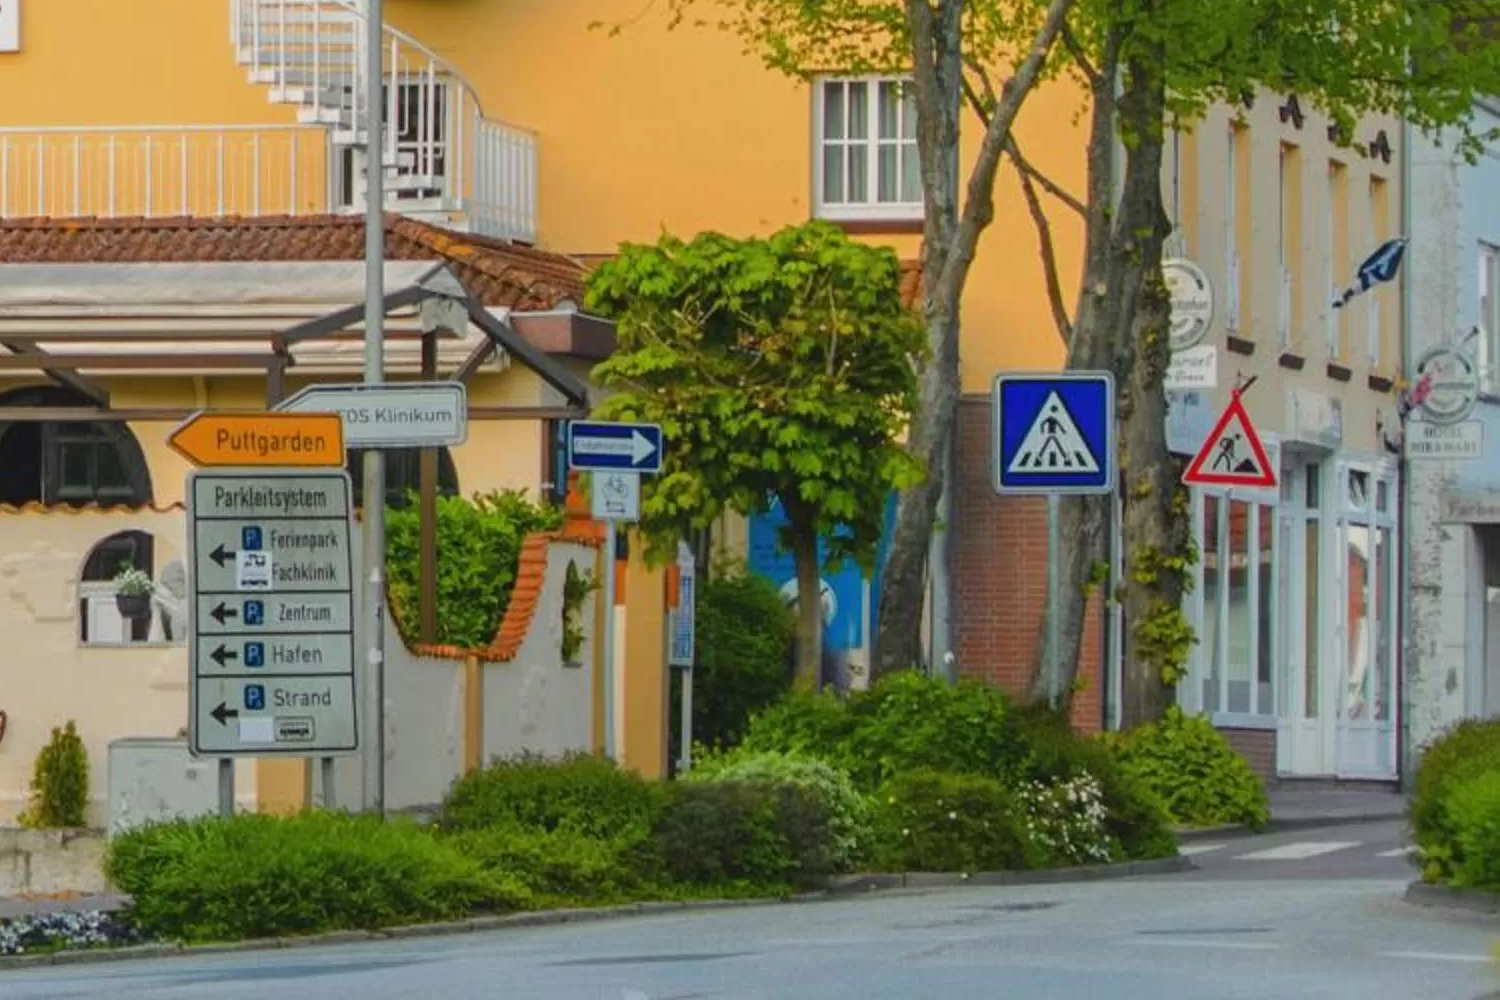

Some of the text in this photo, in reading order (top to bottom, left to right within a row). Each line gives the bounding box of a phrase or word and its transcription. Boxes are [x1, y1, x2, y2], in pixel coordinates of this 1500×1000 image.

[375, 407, 452, 424] Klinikum
[216, 428, 326, 456] Puttgarden
[215, 485, 327, 513] Parkleitsystem
[270, 528, 338, 552] Ferienpark
[272, 562, 337, 582] Fachklinik
[278, 603, 332, 622] Zentrum
[272, 645, 323, 664] Hafen
[273, 686, 332, 707] Strand
